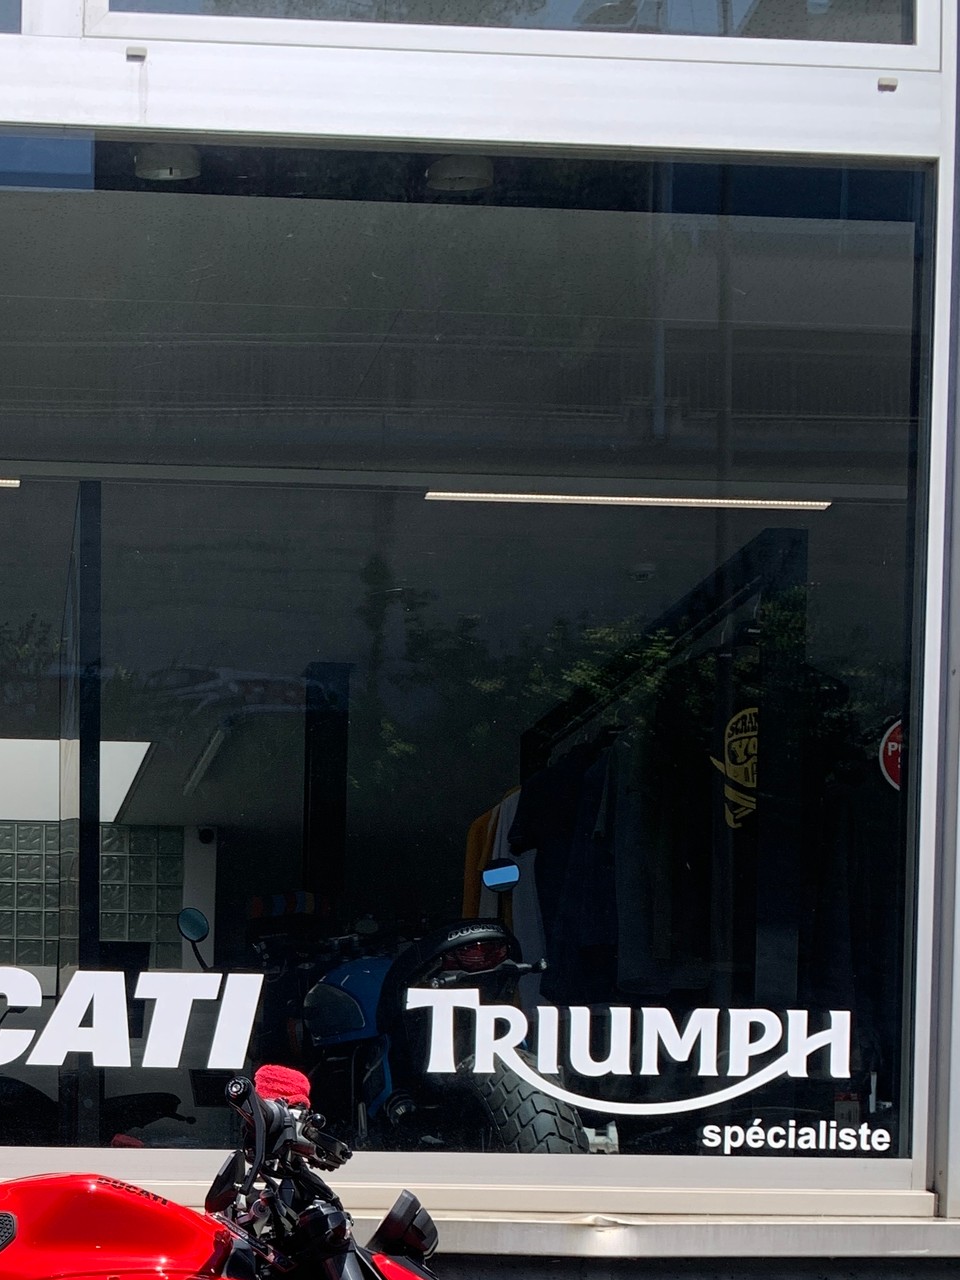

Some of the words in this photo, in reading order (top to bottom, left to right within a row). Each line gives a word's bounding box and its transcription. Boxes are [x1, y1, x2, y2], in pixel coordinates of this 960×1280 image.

[406, 988, 852, 1115] TRIUMPH
[702, 1120, 891, 1155] spécialiste
[97, 1177, 168, 1206] DUCATI
